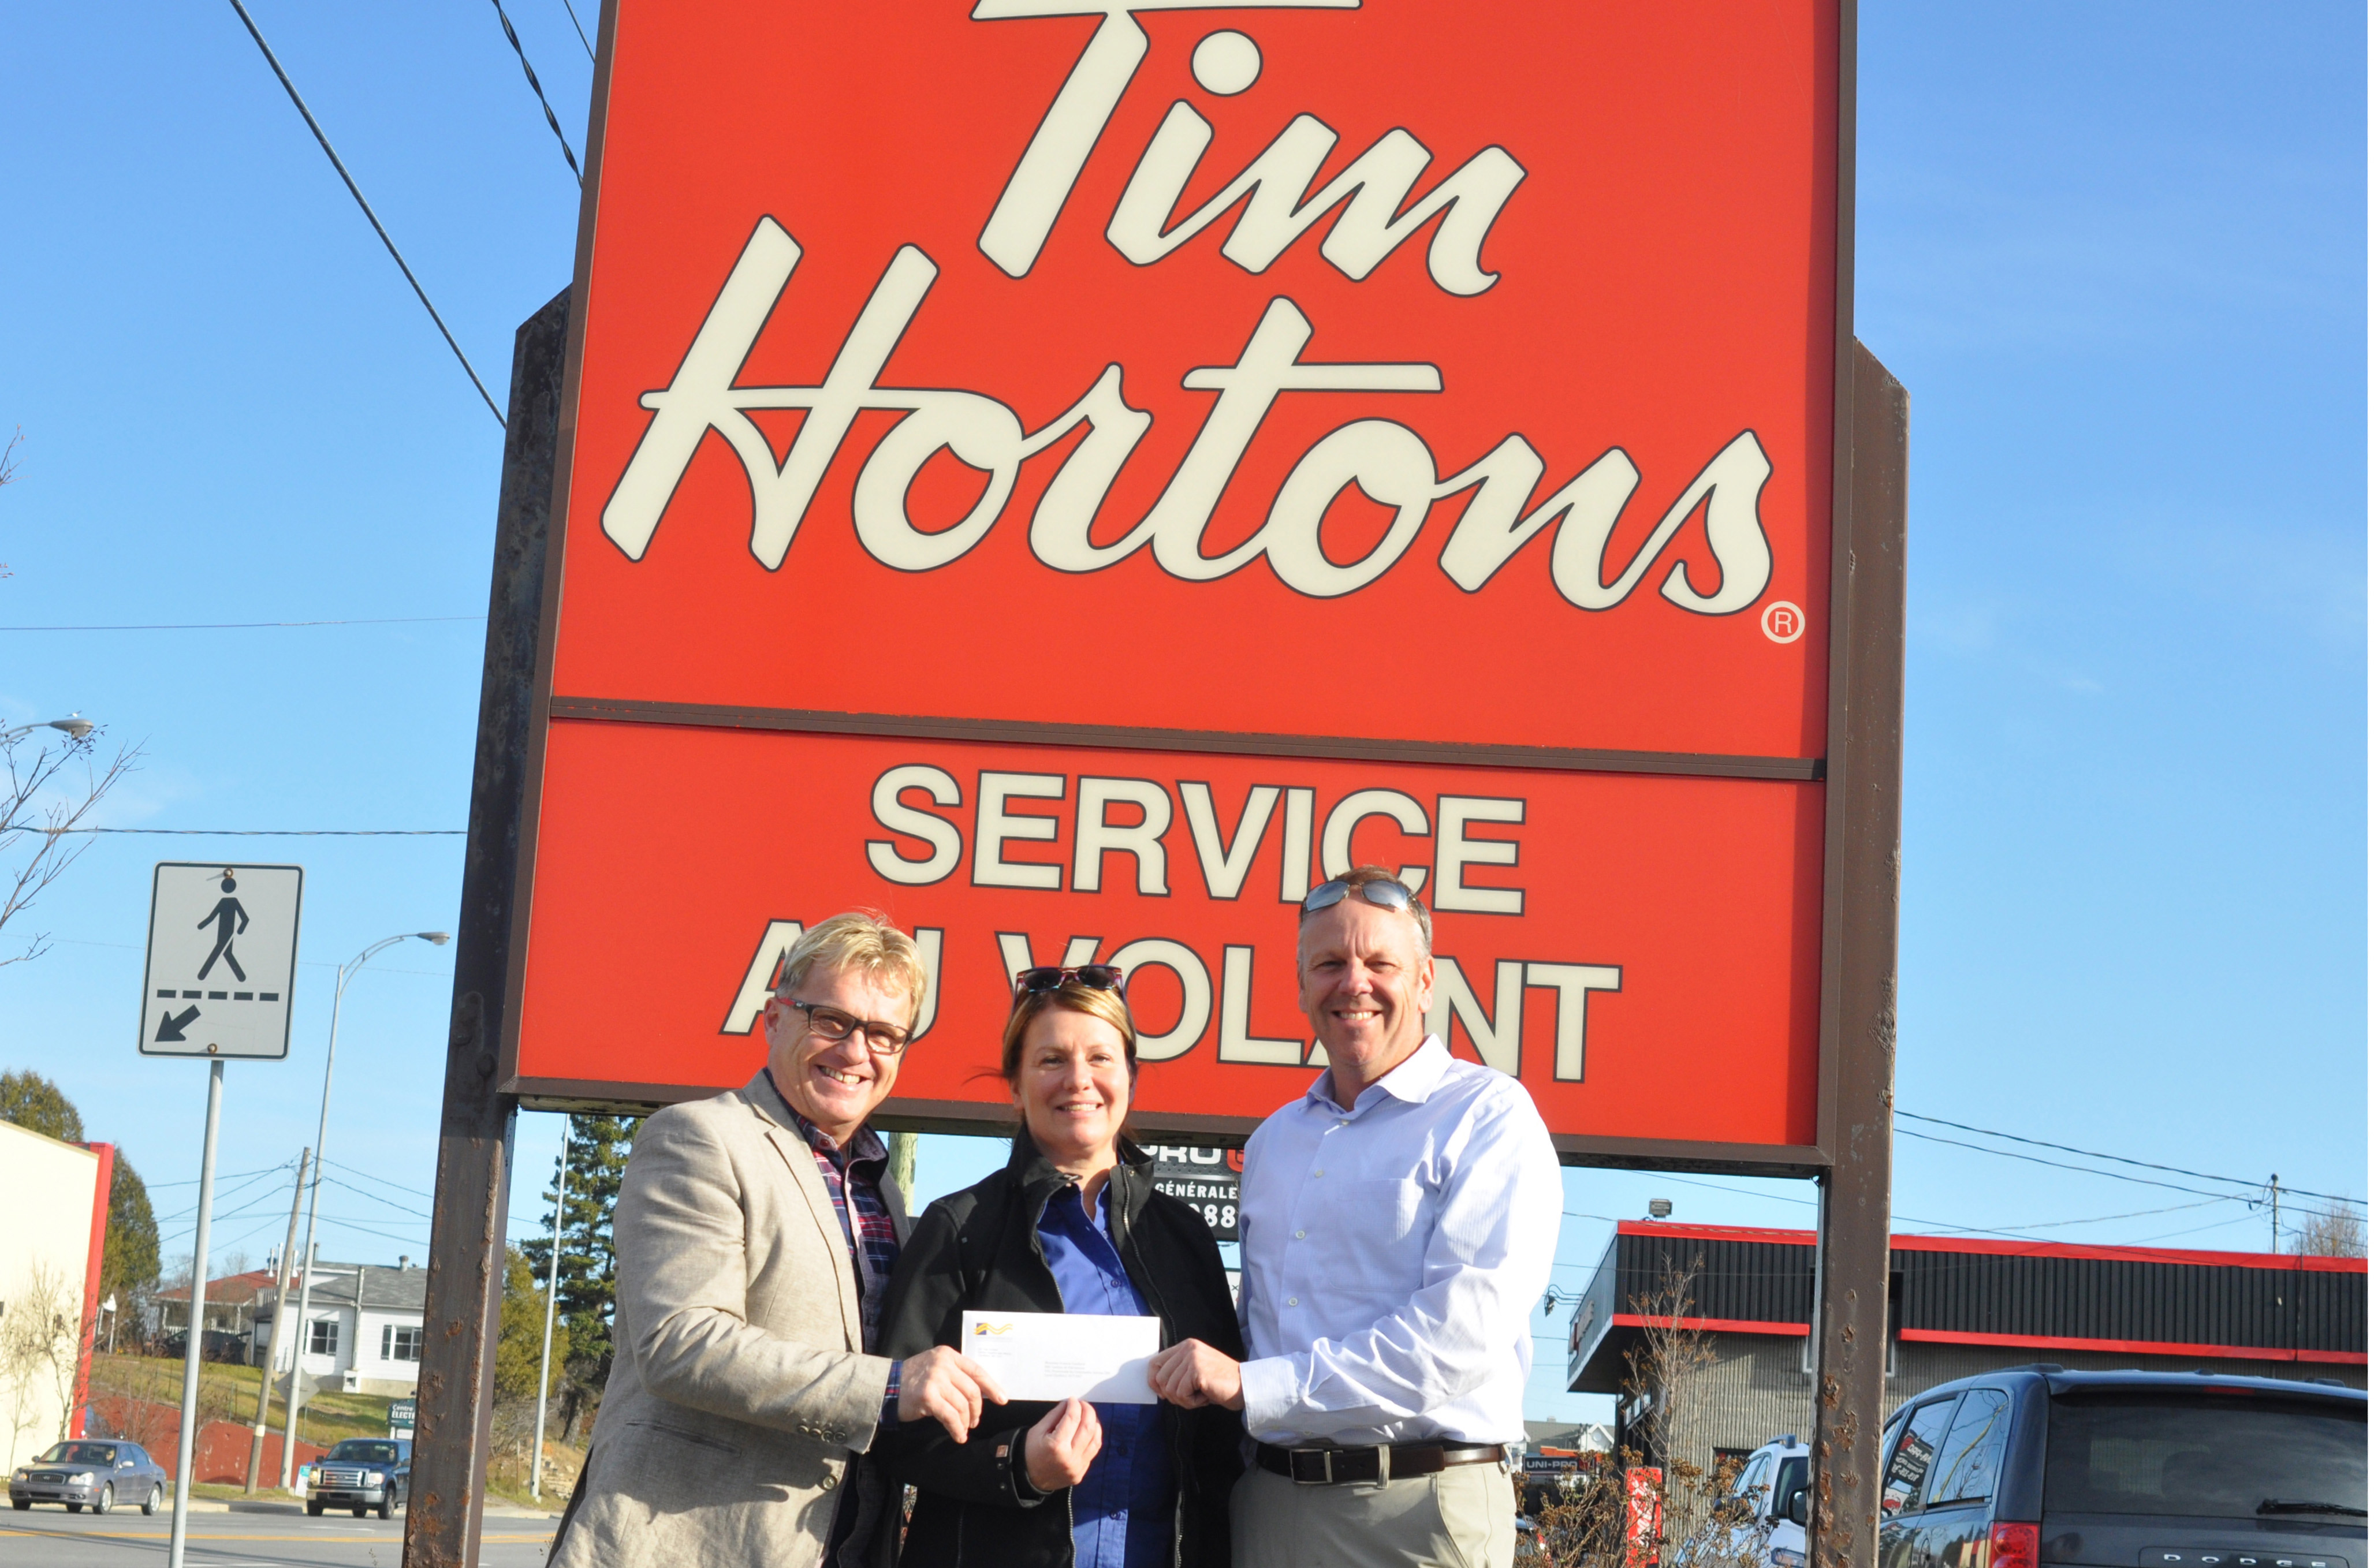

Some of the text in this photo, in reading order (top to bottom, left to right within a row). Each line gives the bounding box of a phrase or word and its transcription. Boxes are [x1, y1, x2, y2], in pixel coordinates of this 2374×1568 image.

[970, 0, 1529, 297] Tim
[601, 213, 1773, 616] Hortons
[865, 763, 1526, 916] SERVICE
[994, 931, 1623, 1084] OLNT
[1155, 1181, 1238, 1199] GÉNÉRALE
[1188, 1203, 1236, 1228] 88
[2164, 1554, 2325, 1568] DODGE
